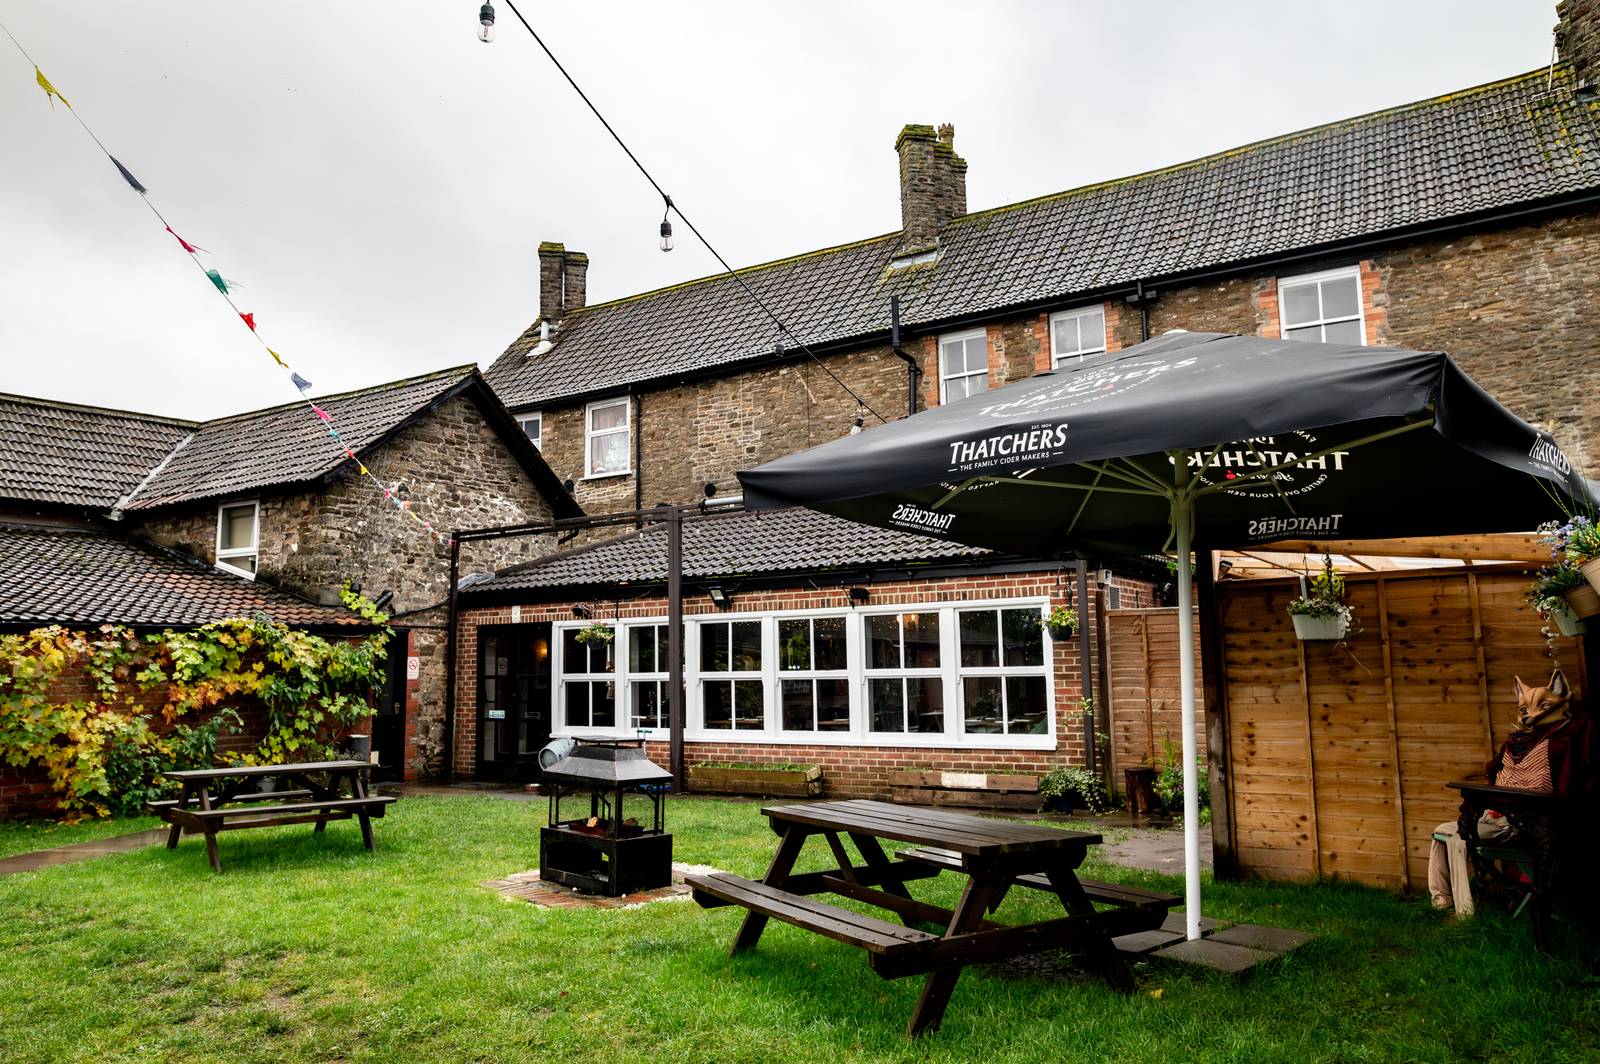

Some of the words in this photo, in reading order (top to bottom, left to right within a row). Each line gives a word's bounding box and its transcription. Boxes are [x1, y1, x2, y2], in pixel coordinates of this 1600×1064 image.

[950, 423, 1069, 465] THATCHERS
[960, 463, 973, 472] THE
[974, 458, 998, 469] FAMILY
[1000, 455, 1020, 465] CIDER
[1022, 451, 1050, 461] MAKERS
